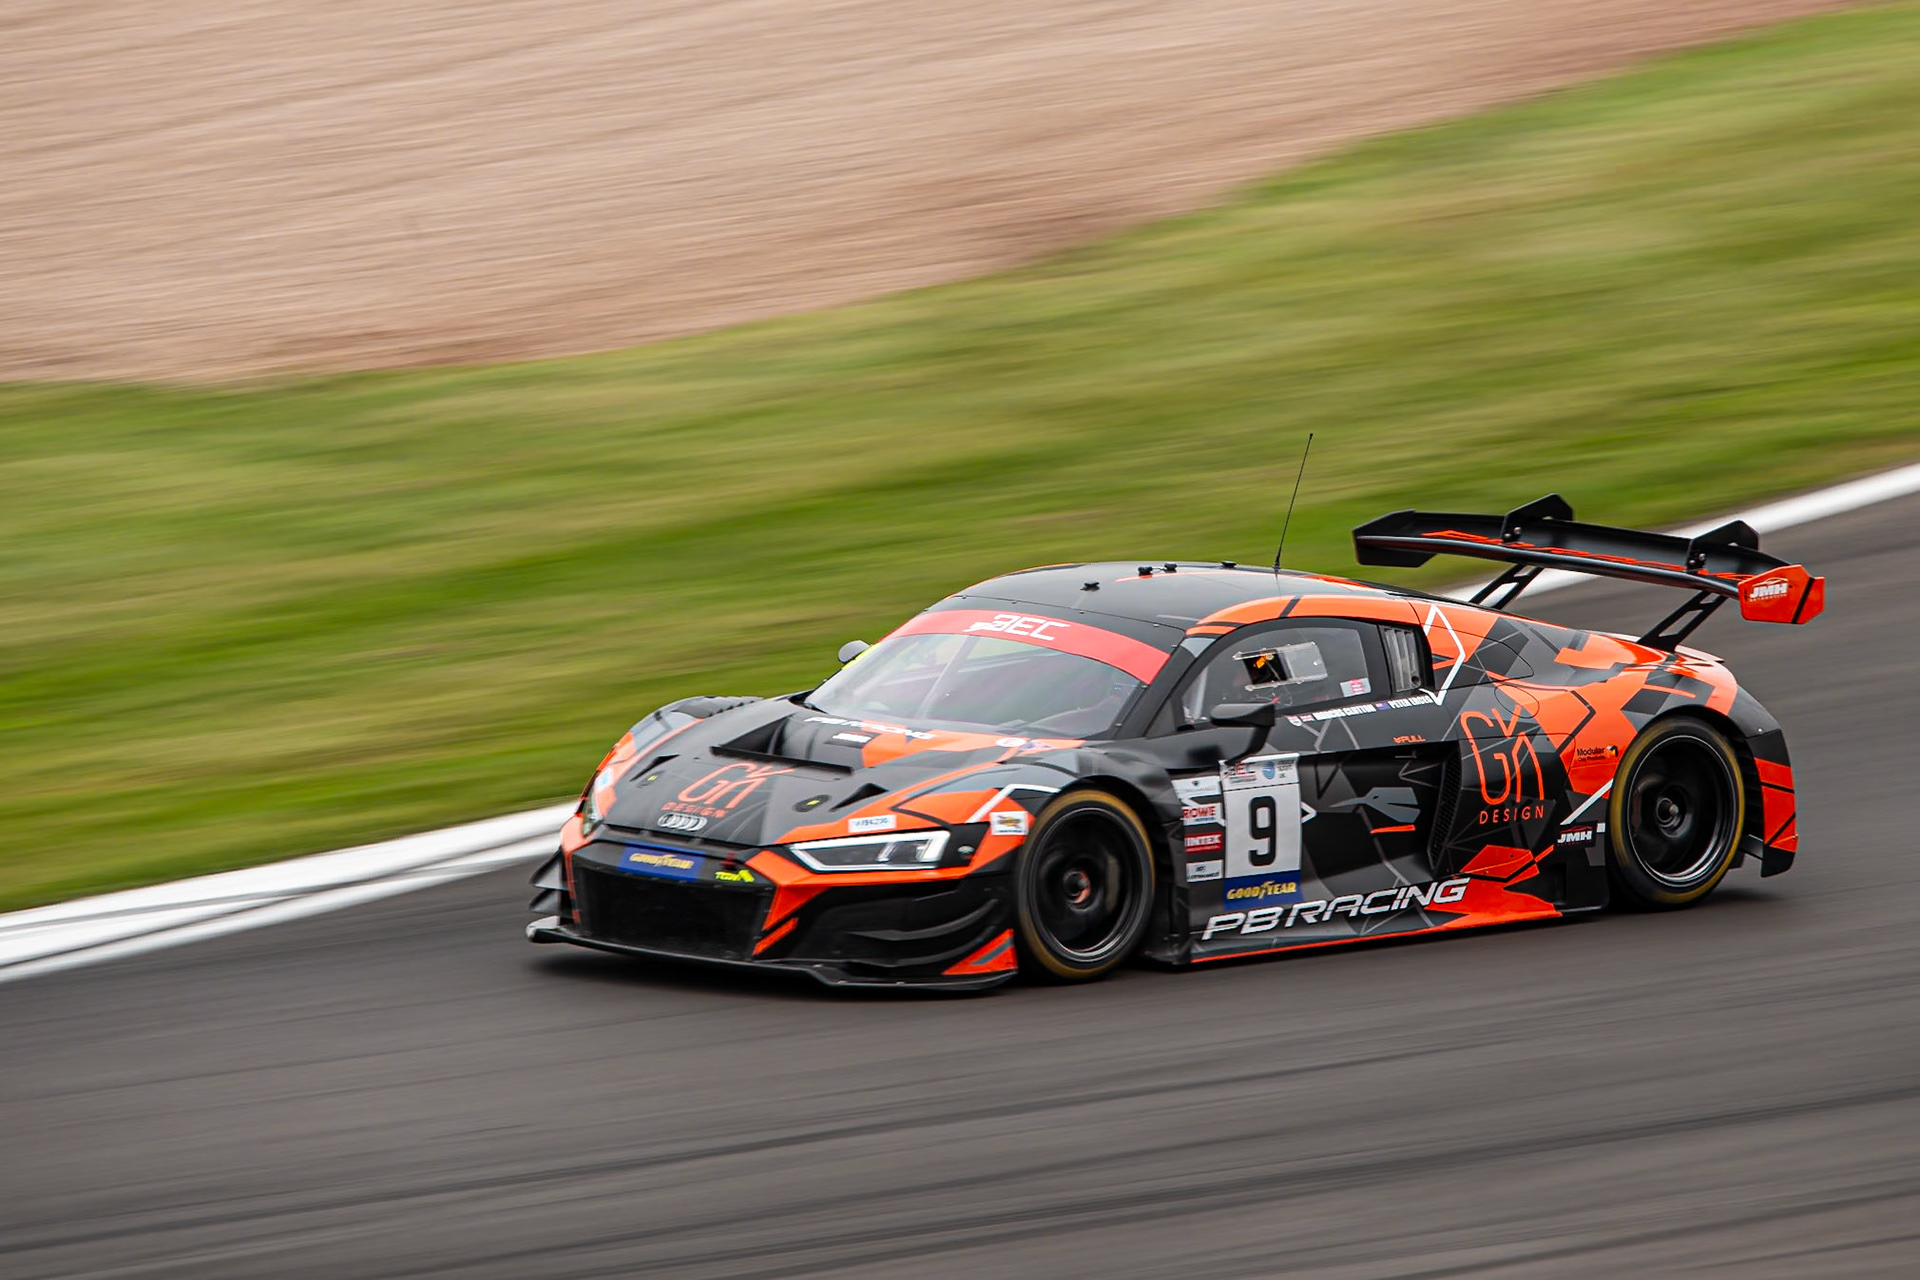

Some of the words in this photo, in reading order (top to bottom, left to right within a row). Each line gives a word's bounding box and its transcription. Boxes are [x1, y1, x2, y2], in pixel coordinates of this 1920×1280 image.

[1749, 582, 1788, 599] JMH
[1402, 734, 1426, 744] PULL
[1576, 745, 1605, 756] Modular
[661, 802, 728, 818] DESIGN
[1182, 805, 1217, 820] ROWE
[1478, 804, 1545, 825] DESIGN
[1248, 795, 1278, 867] 9
[1556, 829, 1592, 844] JMH
[629, 852, 695, 870] GOODYEAR
[1226, 880, 1298, 901] GOODYEAR
[1200, 905, 1286, 942] PB
[1284, 876, 1471, 929] RACING
